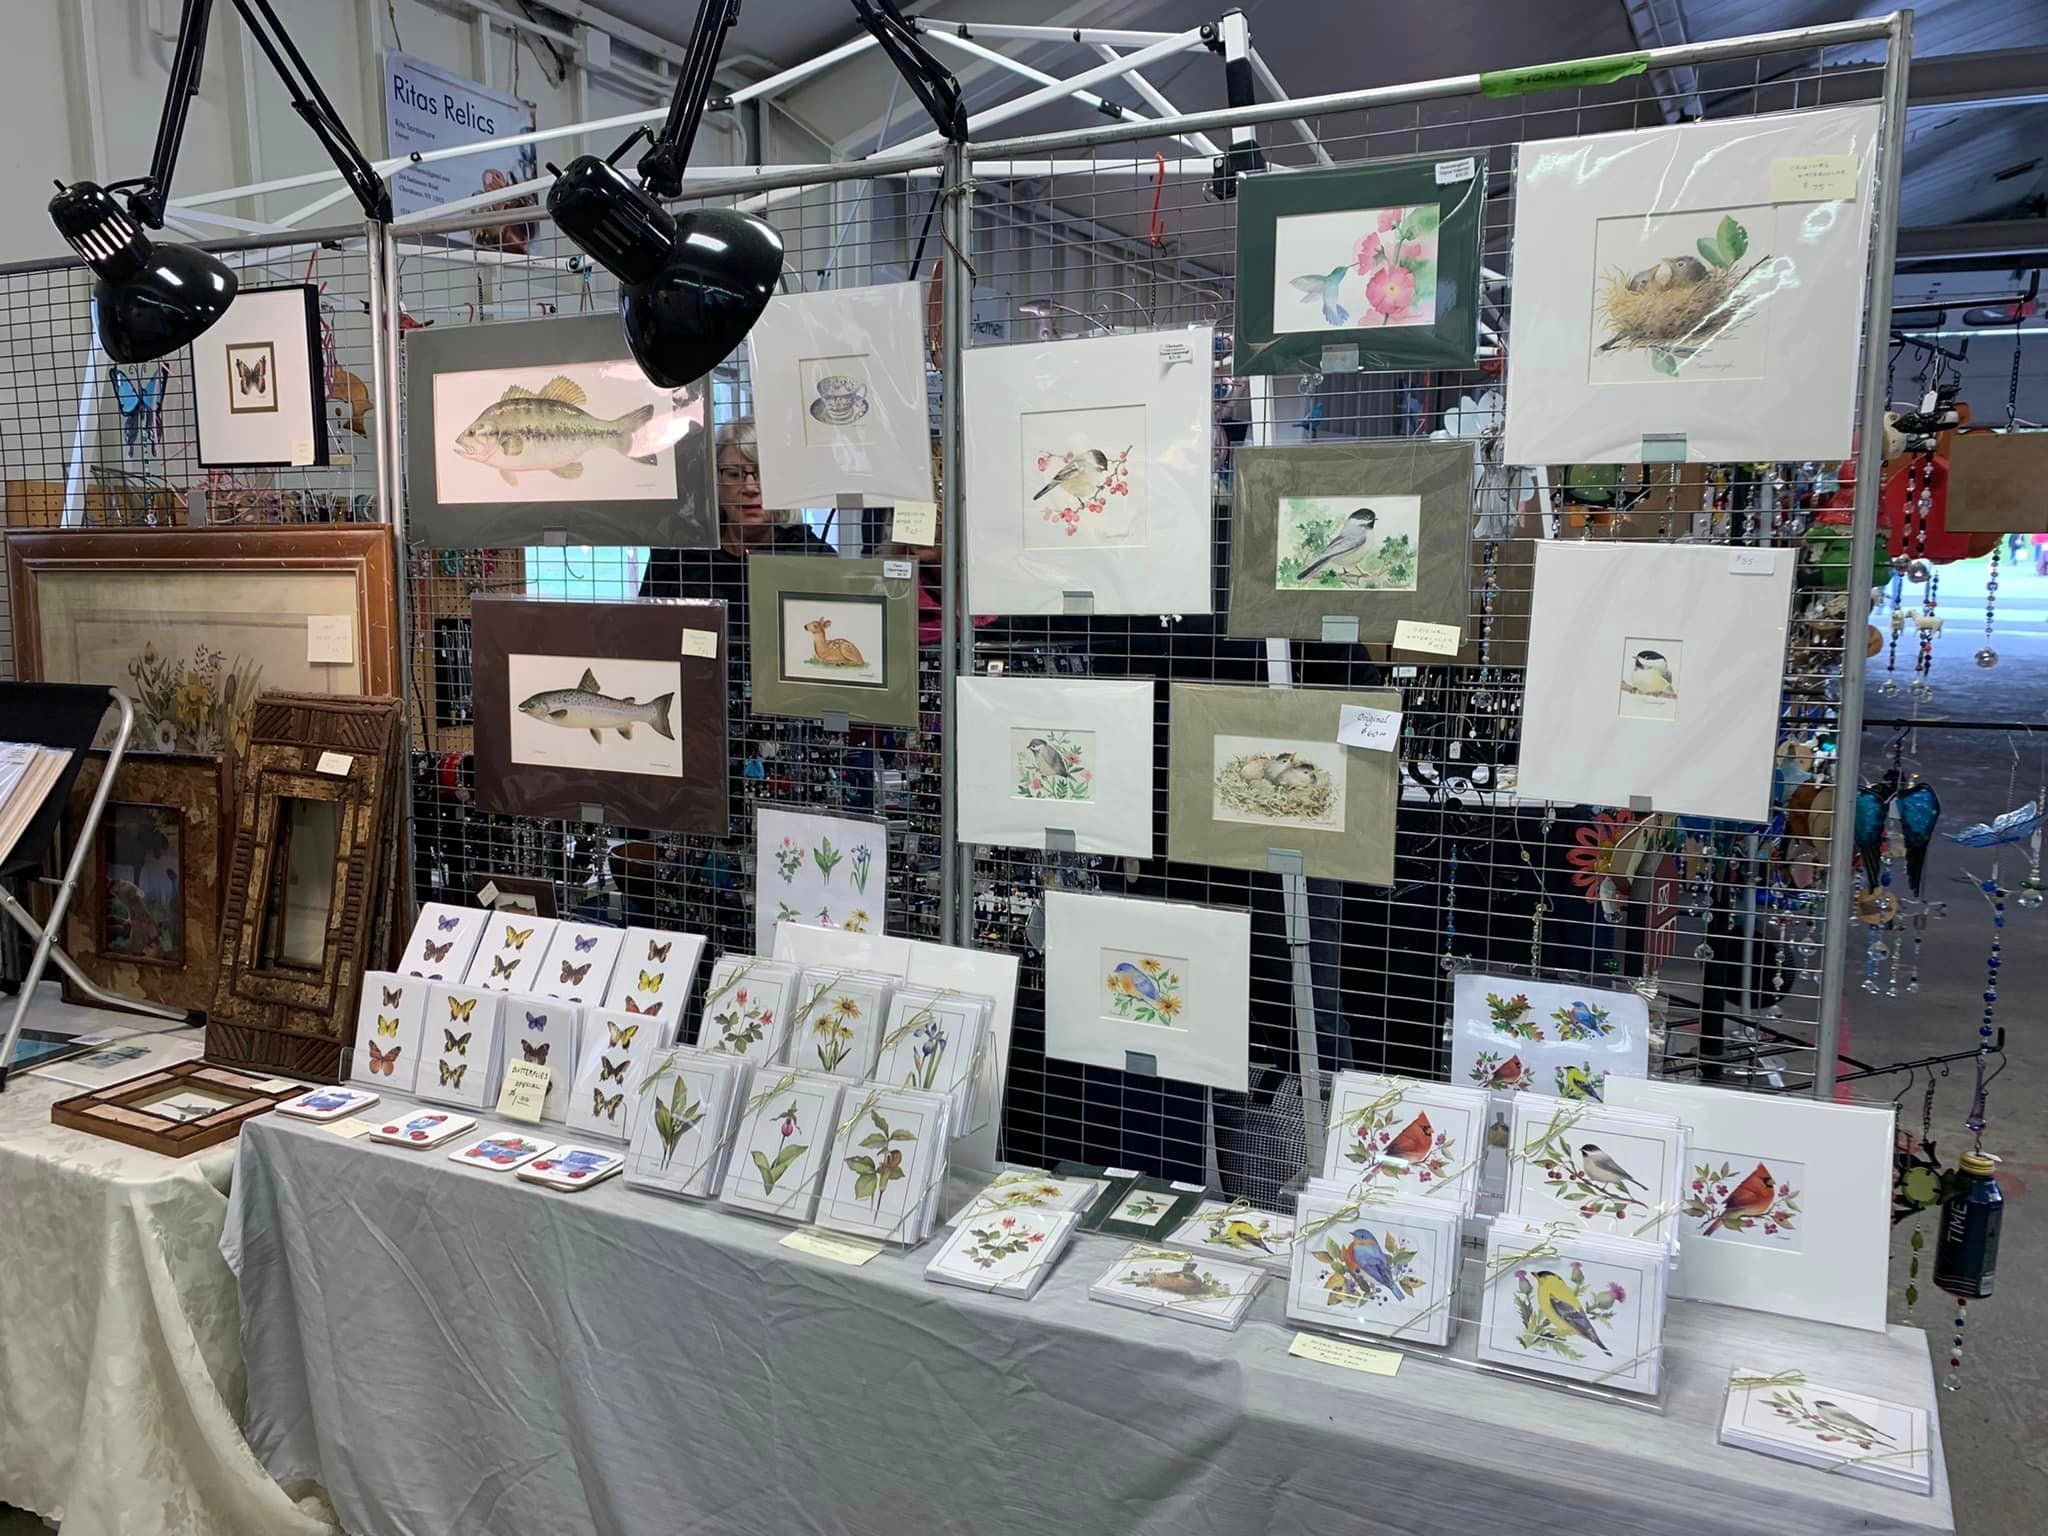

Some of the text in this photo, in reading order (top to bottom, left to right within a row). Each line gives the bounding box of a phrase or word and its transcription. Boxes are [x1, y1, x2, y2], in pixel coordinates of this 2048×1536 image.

[393, 74, 438, 115] Ritas
[444, 95, 495, 136] Relics
[1356, 712, 1392, 727] Original
[511, 1065, 549, 1081] BUTTERFLIES
[1946, 1200, 1968, 1244] TIME
